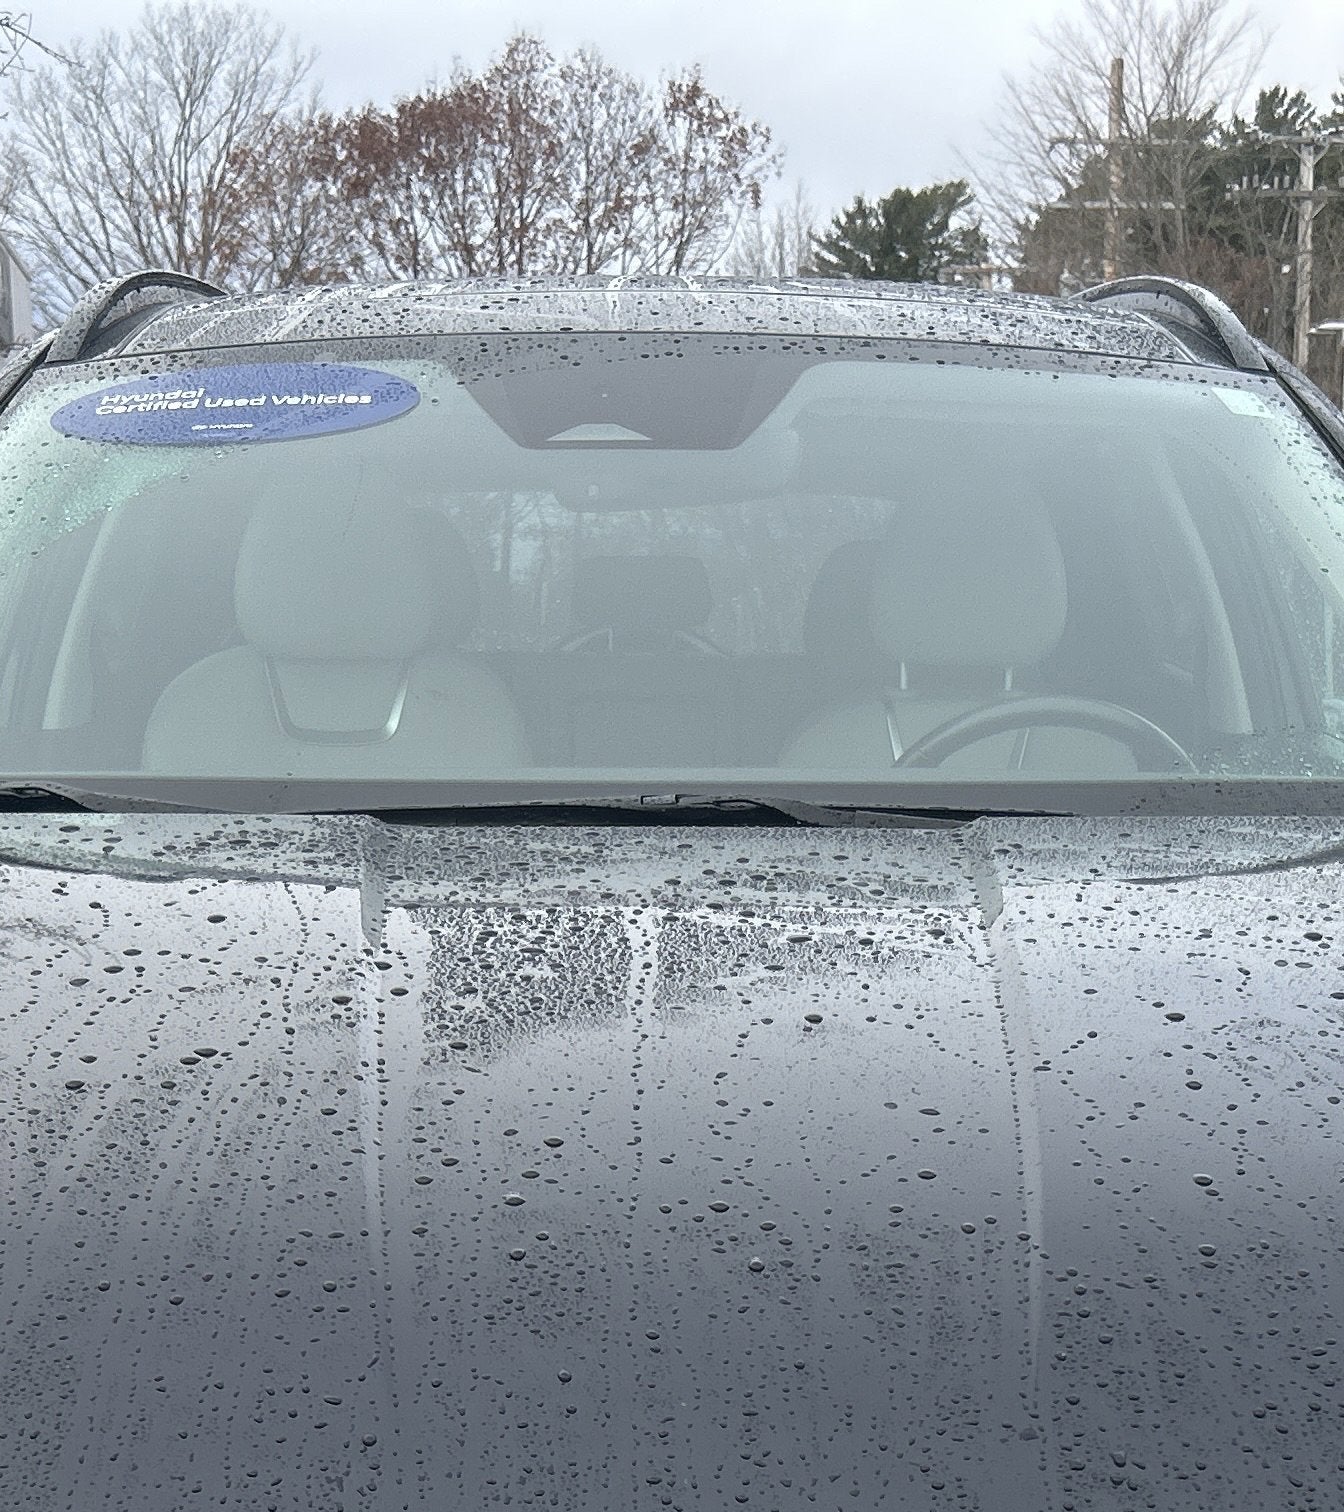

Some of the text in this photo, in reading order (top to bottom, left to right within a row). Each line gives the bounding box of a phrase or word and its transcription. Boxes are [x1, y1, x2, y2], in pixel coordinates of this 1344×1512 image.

[95, 393, 372, 415] Certified Used Vehicles
[100, 387, 206, 406] Hyundai
